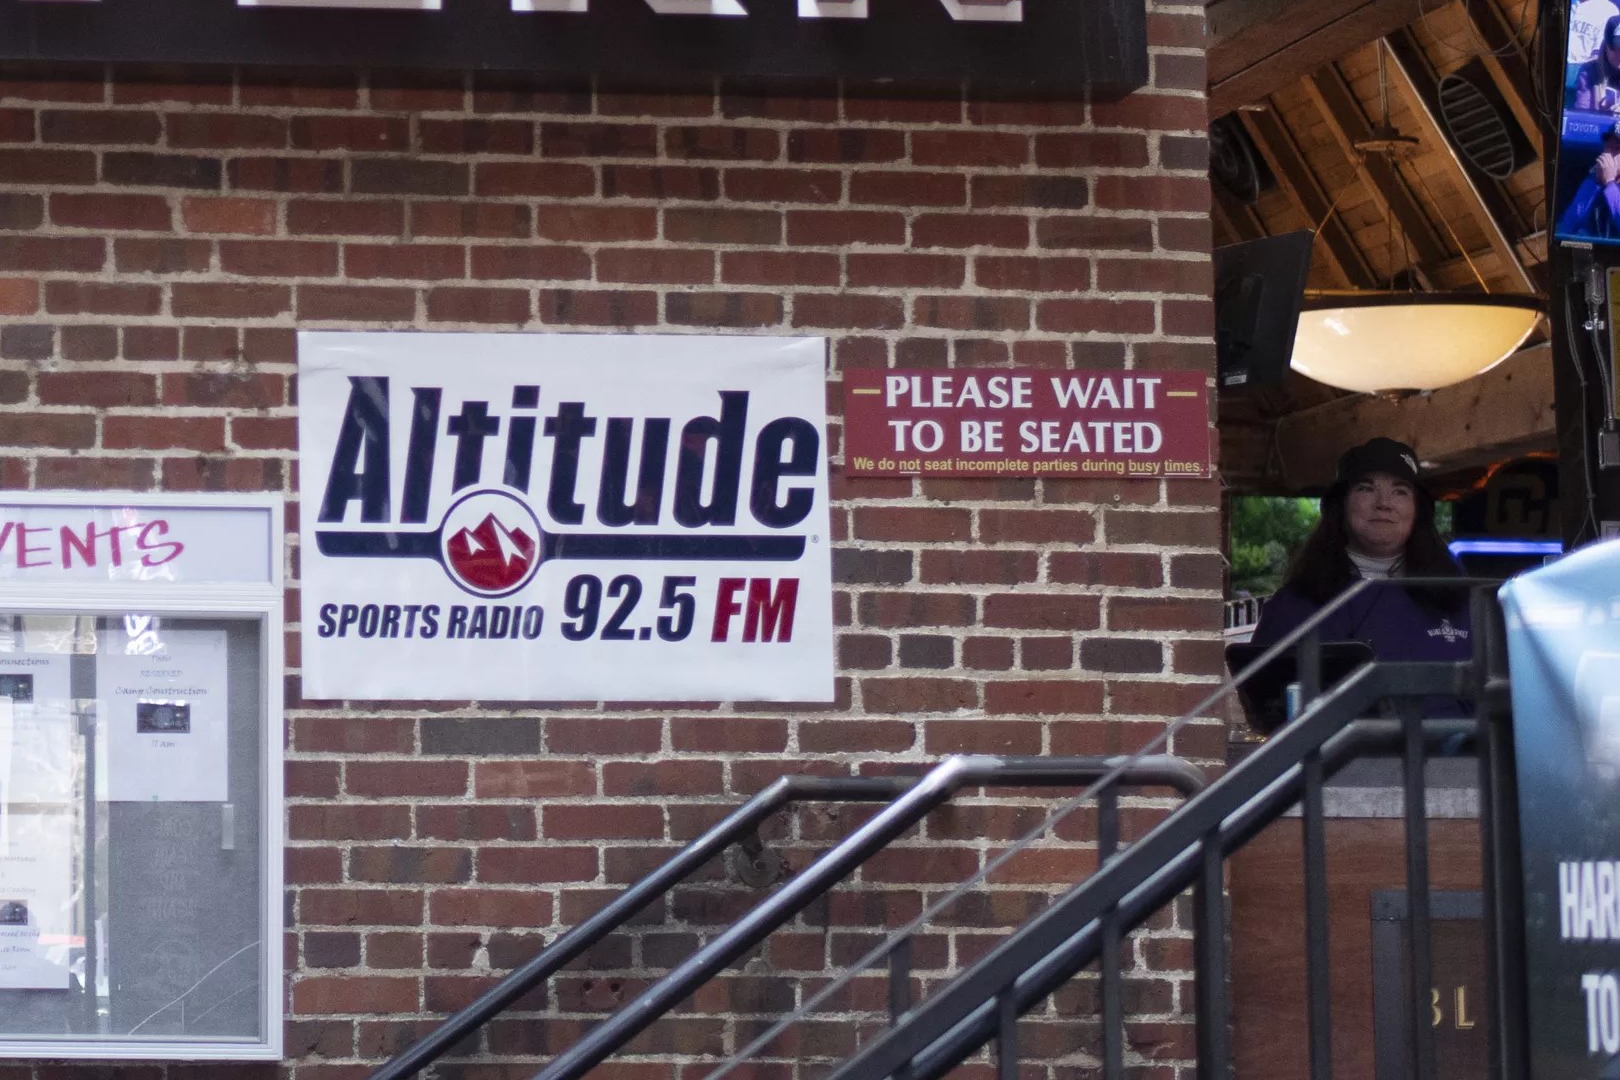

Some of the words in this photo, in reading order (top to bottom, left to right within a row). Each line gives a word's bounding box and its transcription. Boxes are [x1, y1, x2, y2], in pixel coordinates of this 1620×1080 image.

[886, 376, 1033, 409] PLEASE
[1051, 377, 1162, 409] WAIT
[317, 375, 820, 529] Altitude
[888, 420, 944, 453] TO
[961, 421, 1004, 453] BE
[1020, 421, 1163, 454] SEATED
[854, 458, 875, 471] We
[878, 458, 896, 471] do
[899, 459, 921, 472] not
[924, 459, 953, 472] seat
[956, 459, 1029, 475] incomplete
[1033, 459, 1078, 475] parties
[1081, 459, 1125, 475] during
[1129, 459, 1161, 475] busy
[317, 603, 440, 639] SPORTS
[446, 604, 544, 640] RADIO
[561, 574, 696, 642] 92.5
[711, 578, 799, 643] FM
[1559, 860, 1620, 939] HAR
